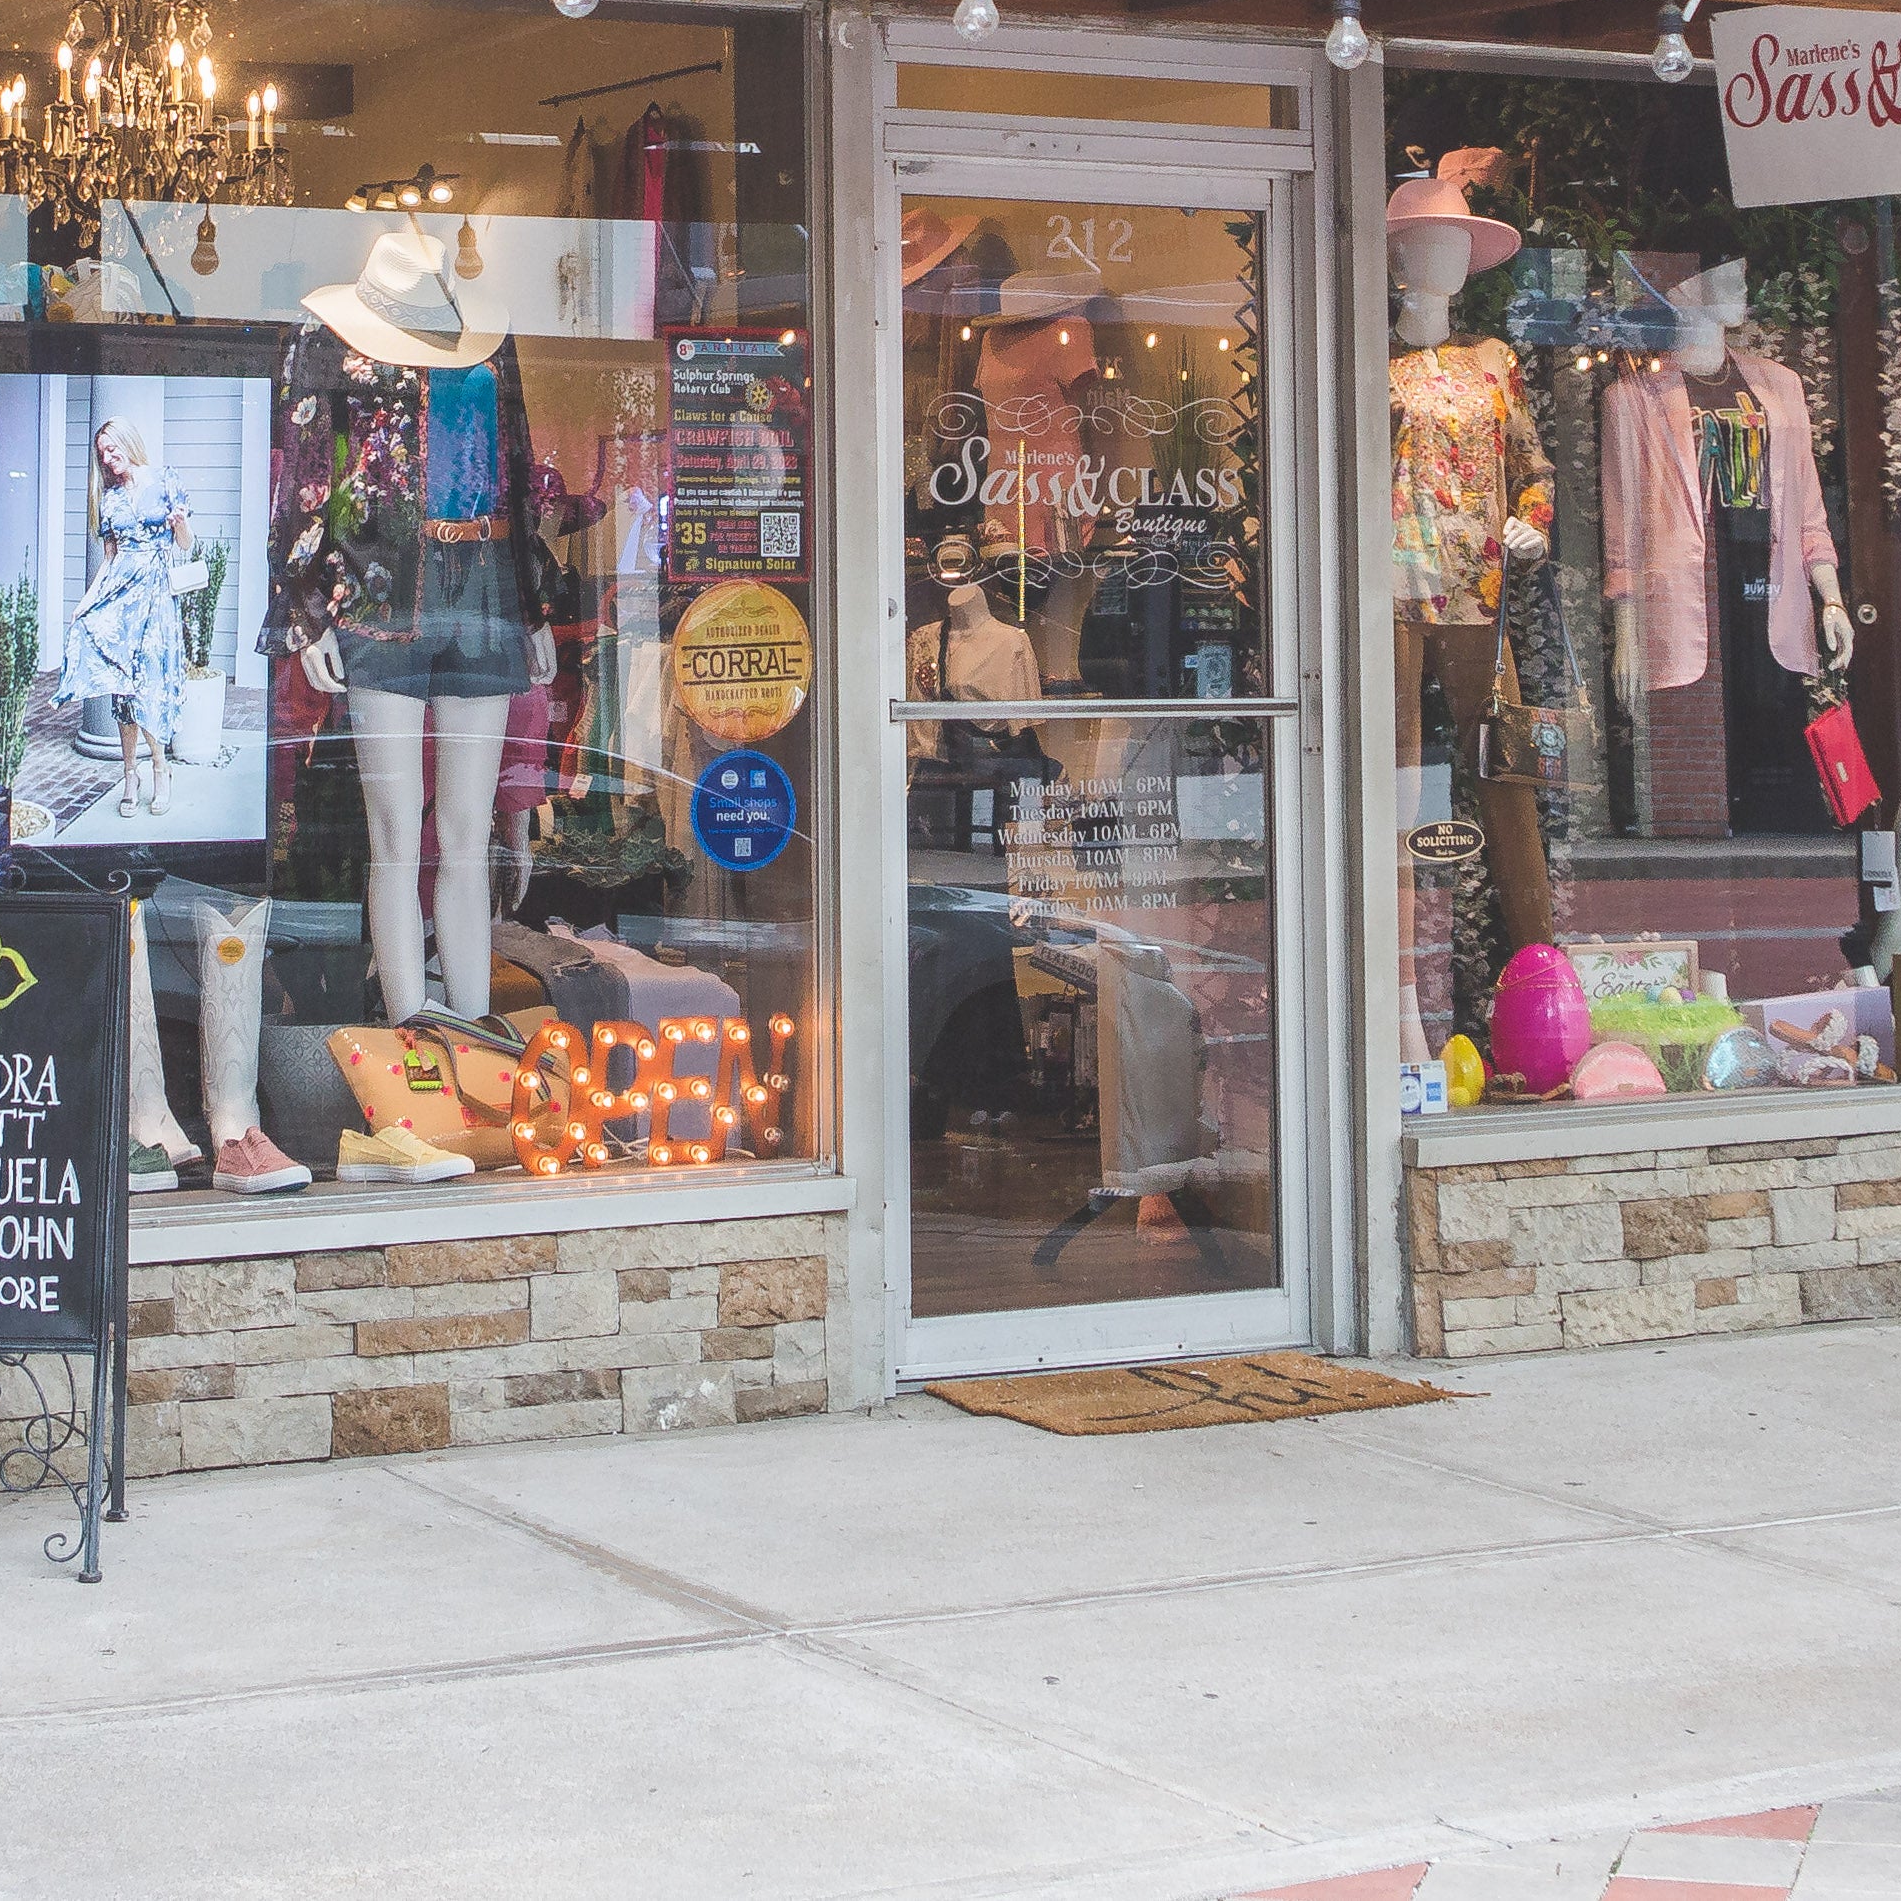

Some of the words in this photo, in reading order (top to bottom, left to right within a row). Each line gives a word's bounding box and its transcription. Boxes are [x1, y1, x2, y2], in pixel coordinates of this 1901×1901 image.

[1785, 40, 1861, 66] Marlene's
[1724, 33, 1862, 129] Sass
[1047, 215, 1132, 262] 212
[673, 368, 714, 381] Sulphur
[717, 369, 755, 384] Springs
[674, 383, 707, 395] Rotary
[710, 384, 731, 394] Club
[674, 409, 707, 421] Claws
[711, 410, 726, 422] for
[729, 414, 736, 422] a
[1005, 449, 1076, 467] Marlene's
[929, 436, 1069, 506] Sass
[1068, 454, 1106, 518] &
[1108, 467, 1242, 508] CLASS
[1114, 509, 1208, 541] Boutique
[705, 558, 763, 572] Signature
[766, 558, 796, 571] Solar
[692, 648, 796, 679] CORRAL
[1009, 781, 1073, 801] Monday
[1078, 778, 1124, 795] 10AM
[1136, 776, 1172, 793] 6PM
[709, 797, 741, 808] Small
[744, 797, 778, 809] shops
[1009, 804, 1075, 823] Tuesday
[1080, 800, 1124, 819] 10AM
[1137, 798, 1173, 816] 6PM
[716, 809, 744, 822] need
[746, 811, 771, 824] you.
[998, 826, 1086, 847] Wednesday
[1092, 823, 1137, 841] 10AM
[1149, 820, 1183, 839] 6PM
[1417, 835, 1474, 847] SOLICITING
[1438, 824, 1453, 835] NO
[1005, 850, 1079, 870] Thursday
[1085, 847, 1129, 866] 10AM
[1143, 845, 1178, 863] 8PM
[1018, 874, 1075, 895] Friday
[1075, 871, 1119, 889] 10AM
[1085, 895, 1128, 913] 10AM
[1142, 893, 1177, 910] 8PM
[512, 1013, 794, 1175] OPEN
